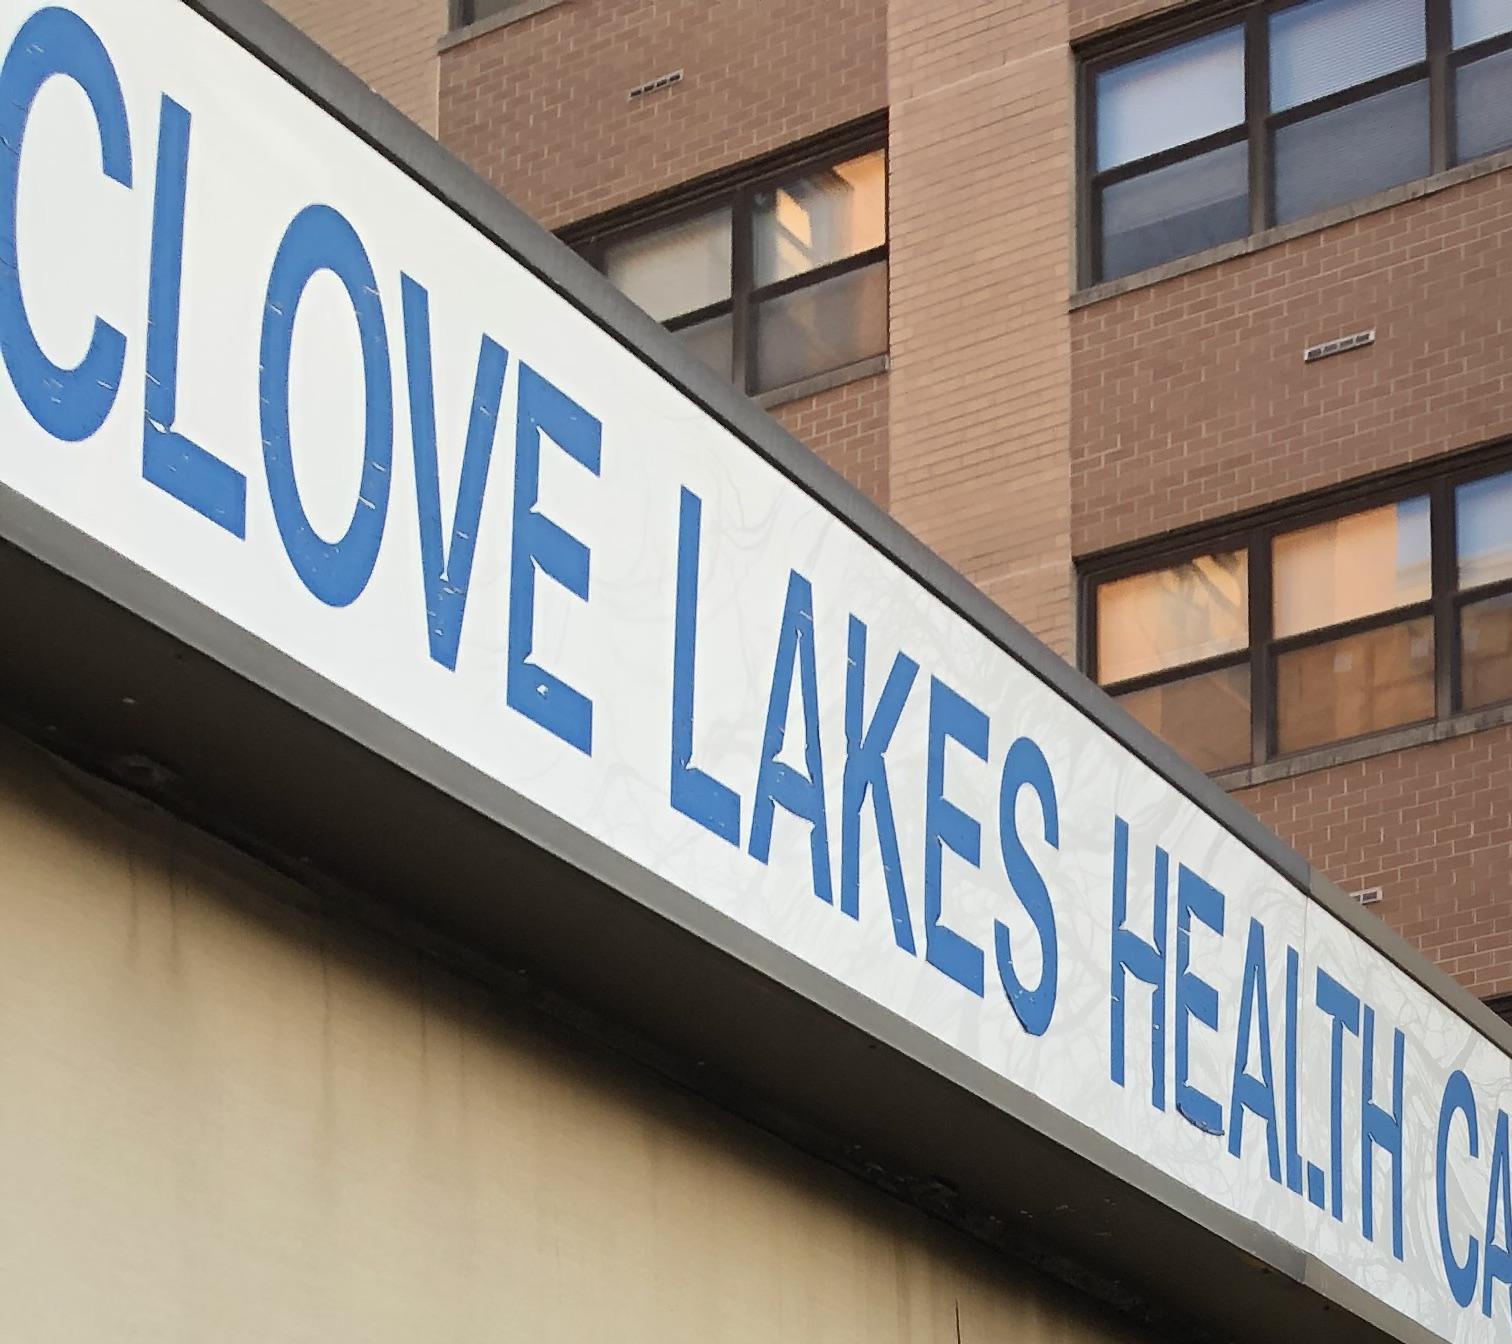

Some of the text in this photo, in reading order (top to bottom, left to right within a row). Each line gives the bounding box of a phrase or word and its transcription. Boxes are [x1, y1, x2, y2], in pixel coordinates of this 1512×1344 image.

[0, 6, 602, 756] CLOVE
[669, 485, 1059, 1036] LAKES
[1110, 815, 1405, 1262] HEALTH
